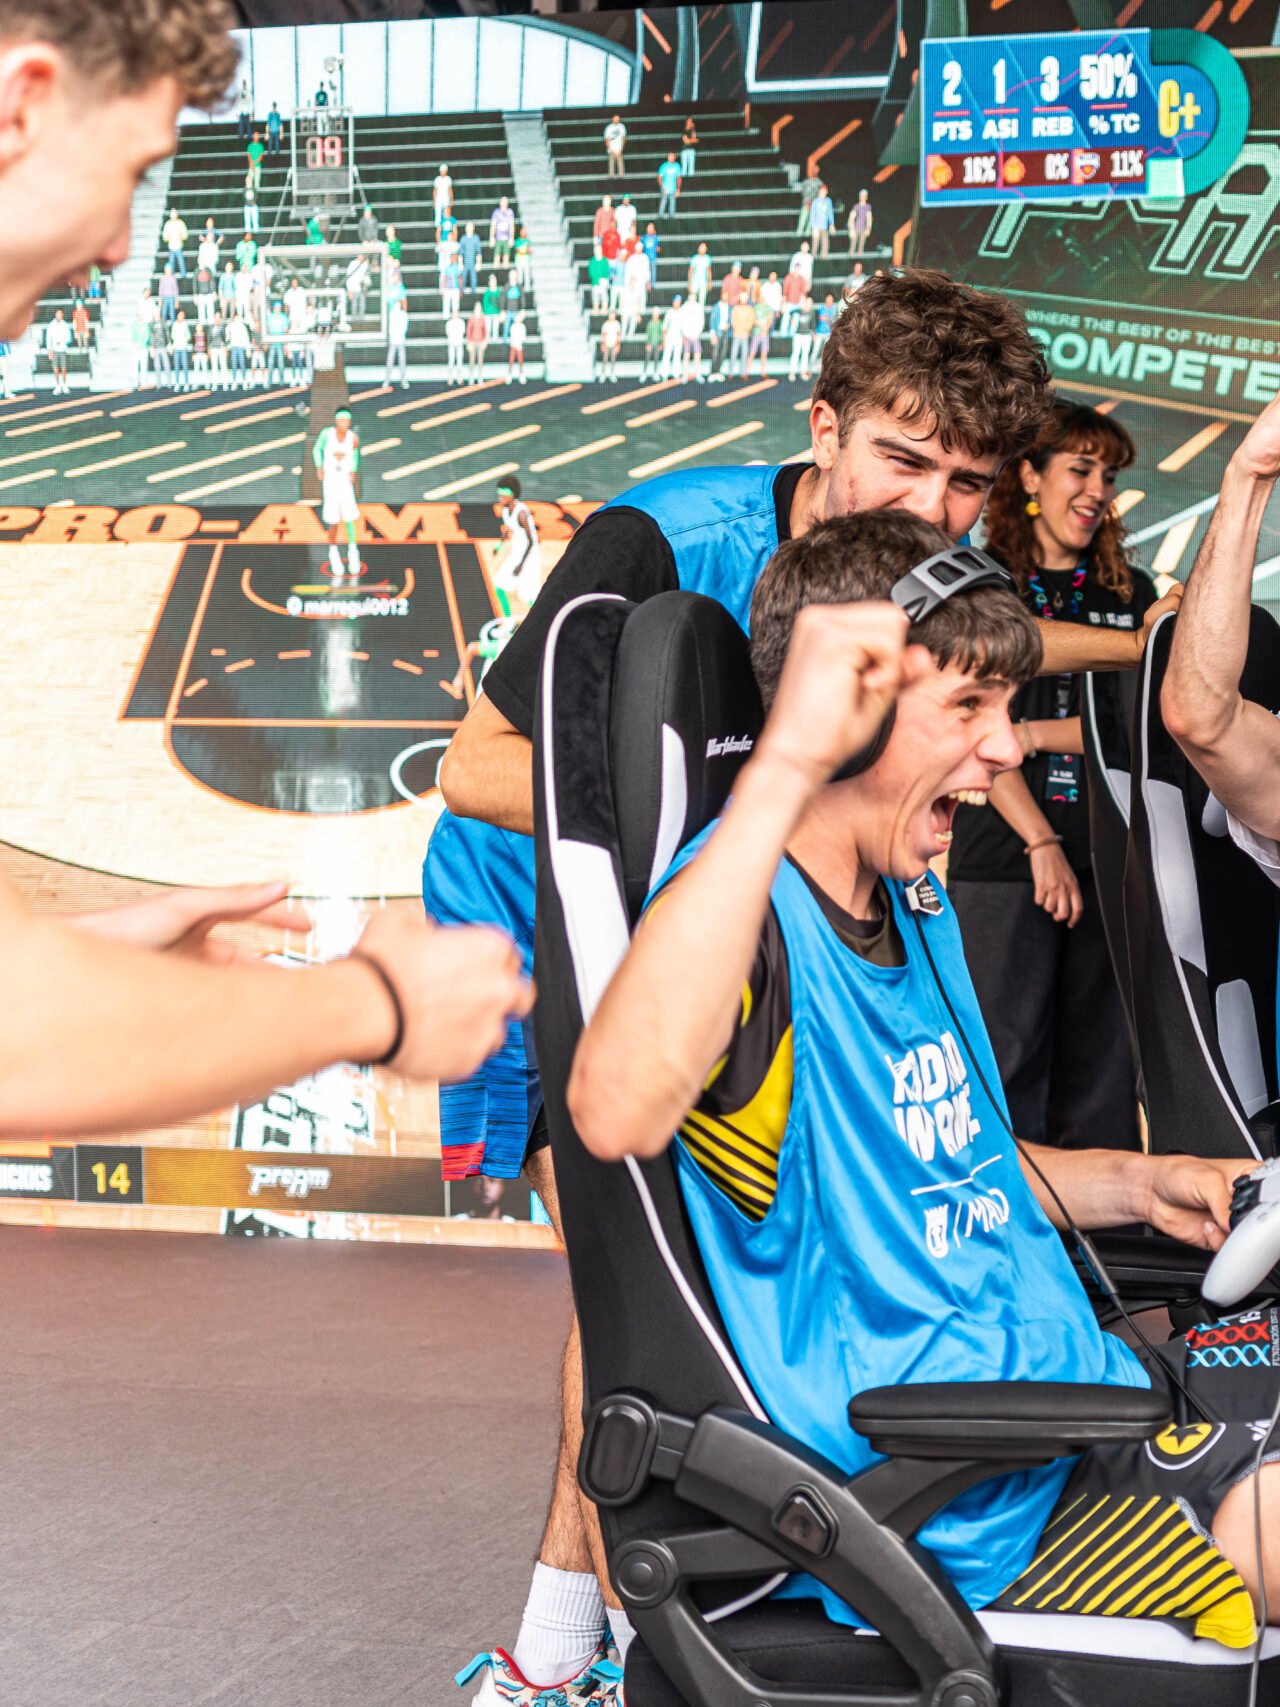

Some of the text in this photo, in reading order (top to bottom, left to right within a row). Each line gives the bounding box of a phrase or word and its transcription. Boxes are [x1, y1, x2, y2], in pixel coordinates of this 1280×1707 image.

[941, 53, 1138, 106] 2 1 3 50%
[1158, 79, 1201, 138] C+
[932, 119, 973, 142] PTS
[982, 117, 1019, 139] ASI
[1032, 115, 1073, 138] REB
[1111, 112, 1141, 134] TC
[1109, 149, 1144, 178] 11%
[1024, 309, 1081, 330] WHERE
[1083, 316, 1115, 335] THE
[1117, 321, 1164, 340] BEST
[1165, 327, 1192, 344] OF
[1195, 331, 1234, 348] THE
[91, 1162, 131, 1195] 14
